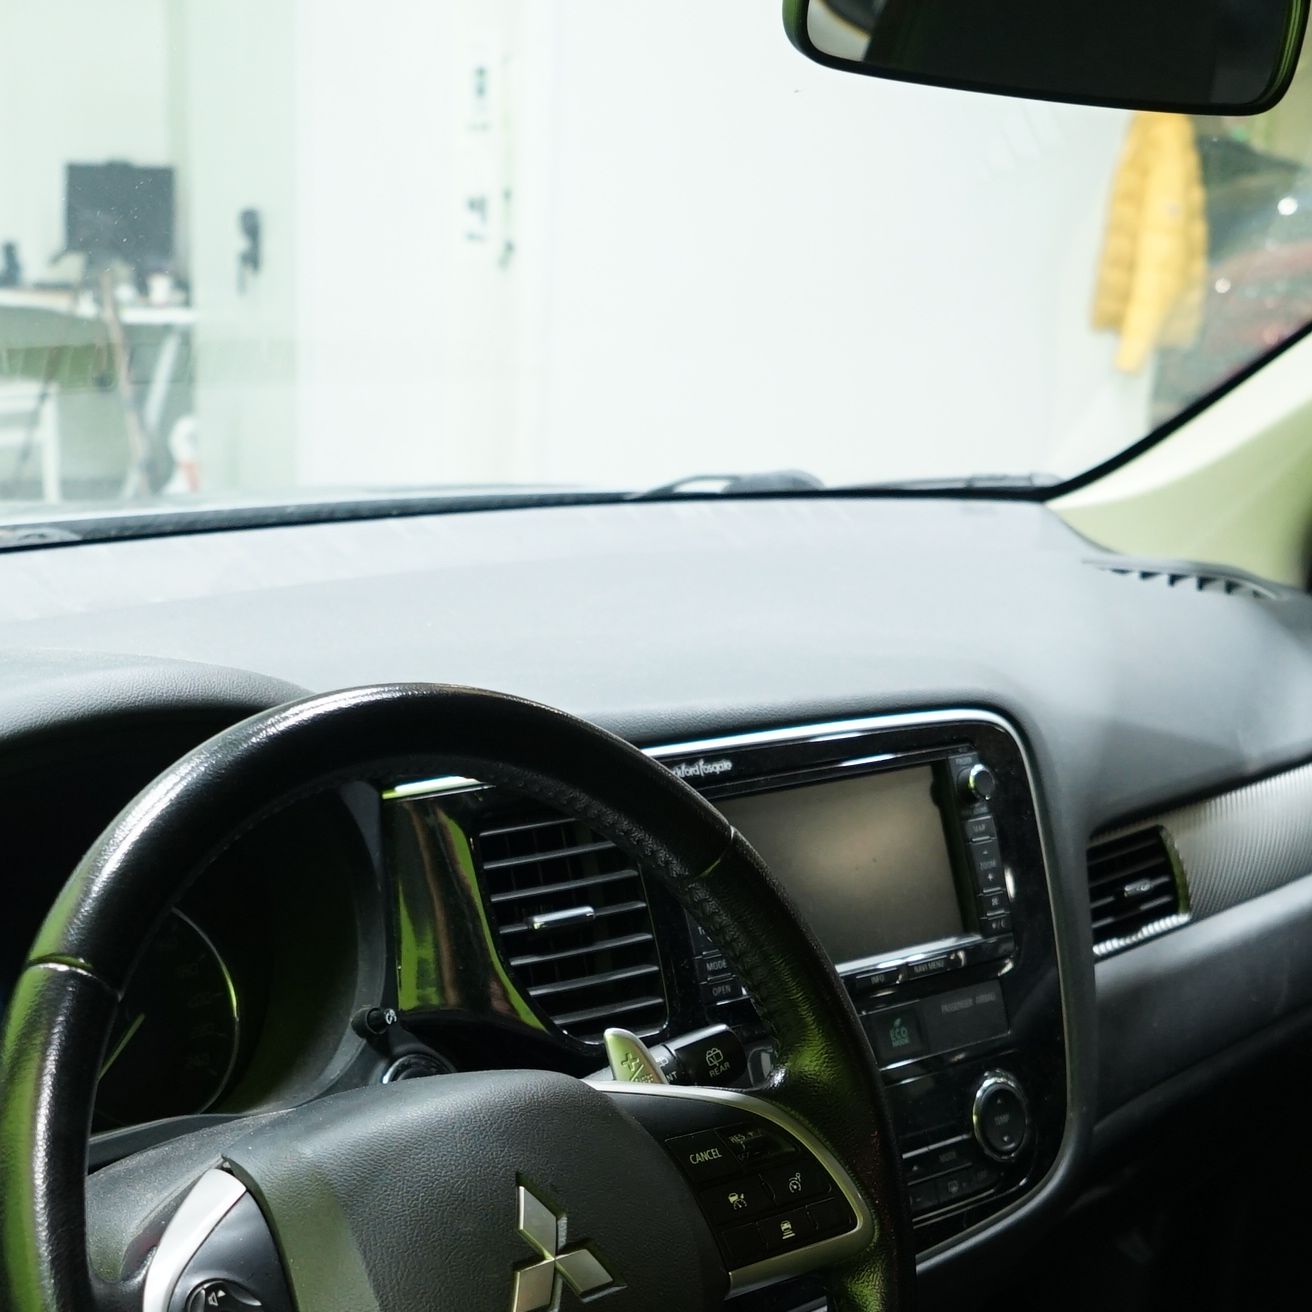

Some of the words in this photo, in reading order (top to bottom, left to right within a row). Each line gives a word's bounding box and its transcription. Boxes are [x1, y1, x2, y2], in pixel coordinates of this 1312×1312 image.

[706, 959, 728, 971] MODE
[712, 985, 731, 996] OPEN
[708, 1061, 731, 1077] REAR
[689, 1147, 723, 1165] CANCEL
